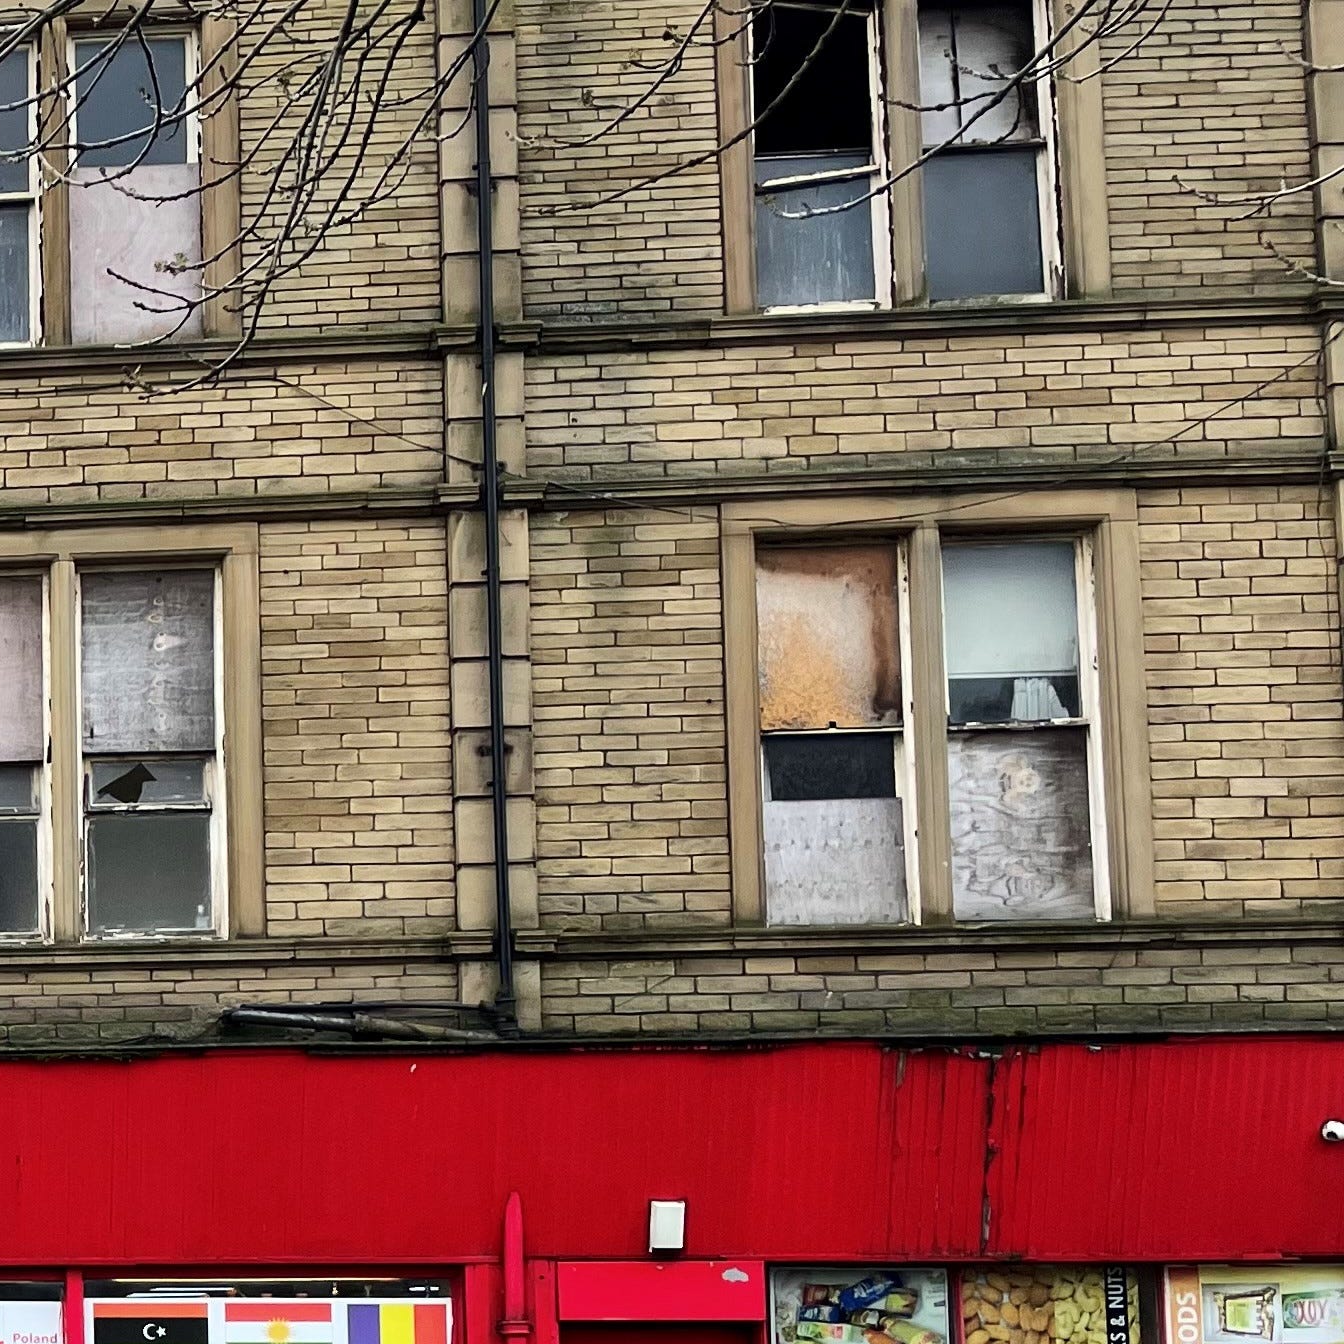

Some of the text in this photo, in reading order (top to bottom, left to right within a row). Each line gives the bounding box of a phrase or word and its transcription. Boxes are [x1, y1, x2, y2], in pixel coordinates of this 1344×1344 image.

[1107, 1266, 1124, 1308] NUTS
[1110, 1314, 1125, 1326] &
[13, 1333, 58, 1344] Poland
